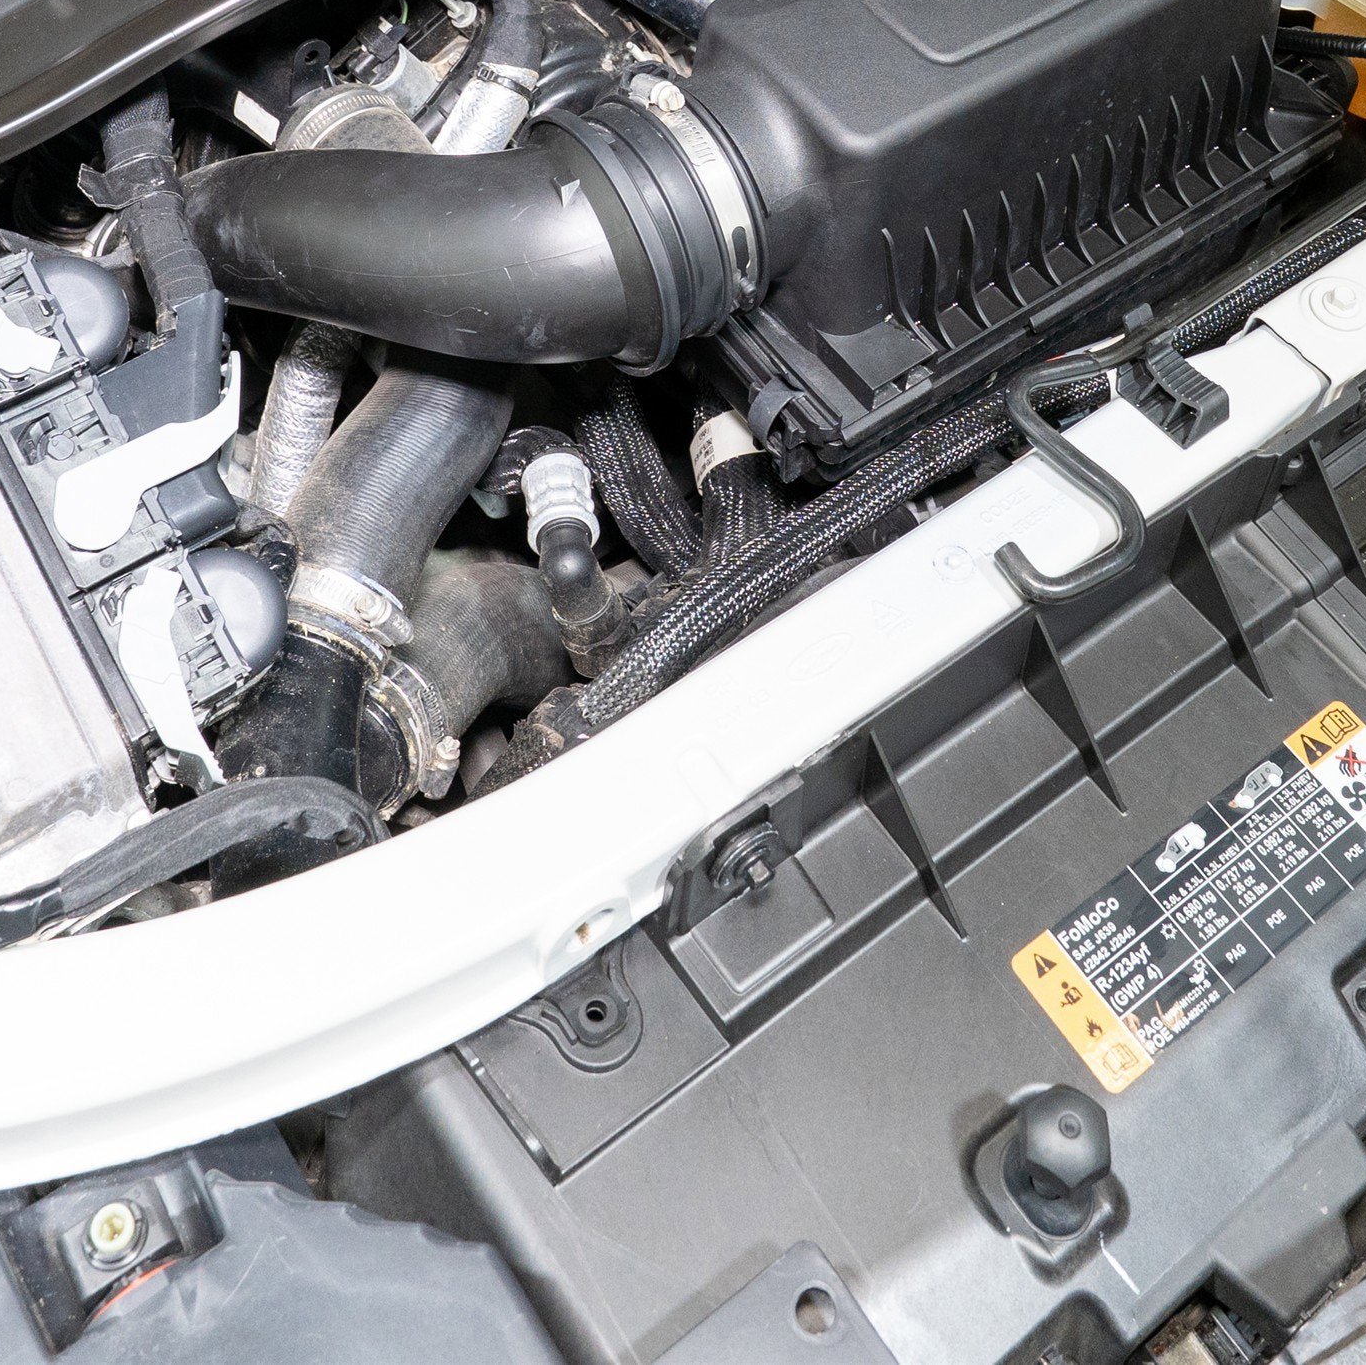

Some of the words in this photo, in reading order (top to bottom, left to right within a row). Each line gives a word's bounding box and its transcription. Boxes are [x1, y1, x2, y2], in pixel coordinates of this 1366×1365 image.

[1275, 787, 1295, 803] 3.3L
[1289, 771, 1312, 792] FHEV
[1282, 795, 1302, 811] 3.0L
[1296, 778, 1320, 800] PHEV
[1245, 812, 1267, 830] 2.3L,
[1294, 800, 1323, 826] 0.992
[1315, 793, 1335, 808] kg
[1311, 815, 1326, 830] 35
[1322, 809, 1335, 822] oz
[1242, 827, 1262, 844] 3.0L
[1257, 821, 1269, 832] &
[1263, 810, 1283, 827] 3.3L
[1255, 830, 1284, 857] 0.992
[1277, 823, 1297, 839] kg
[1316, 823, 1336, 843] 2.19
[1330, 816, 1348, 831] lbs
[1203, 860, 1223, 877] 3.3L
[1217, 842, 1242, 865] FHEV
[1273, 845, 1288, 861] 35
[1283, 839, 1298, 853] oz
[1278, 854, 1298, 874] 2.19
[1292, 846, 1310, 862] lbs
[1343, 842, 1366, 864] POE
[1214, 865, 1242, 893] 0.737
[1236, 857, 1257, 874] kg
[1231, 880, 1247, 896] 26
[1242, 874, 1257, 888] oz
[1304, 875, 1327, 897] PAG
[1162, 893, 1182, 910] 3.0L
[1178, 886, 1189, 898] &
[1184, 875, 1204, 892] 3.3L
[1175, 898, 1206, 925] 0.680
[1197, 888, 1218, 906] kg
[1237, 889, 1257, 909] 1.63
[1251, 881, 1269, 897] lbs
[1056, 896, 1120, 951] FoMoCo
[1192, 913, 1208, 930] 24
[1203, 906, 1218, 921] oz
[1197, 922, 1218, 942] 1.50
[1212, 914, 1230, 930] lbs
[1265, 908, 1288, 930] POE
[1071, 938, 1097, 962] SAE
[1092, 920, 1117, 945] J639
[1080, 945, 1112, 974] J2842
[1108, 924, 1137, 953] J2845
[1224, 942, 1248, 965] PAG
[1094, 941, 1152, 995] R-1234yf
[1108, 973, 1152, 1015] (GWP
[1145, 962, 1165, 985] 4)
[1134, 1015, 1166, 1045] PAG
[1143, 1025, 1175, 1057] POE
